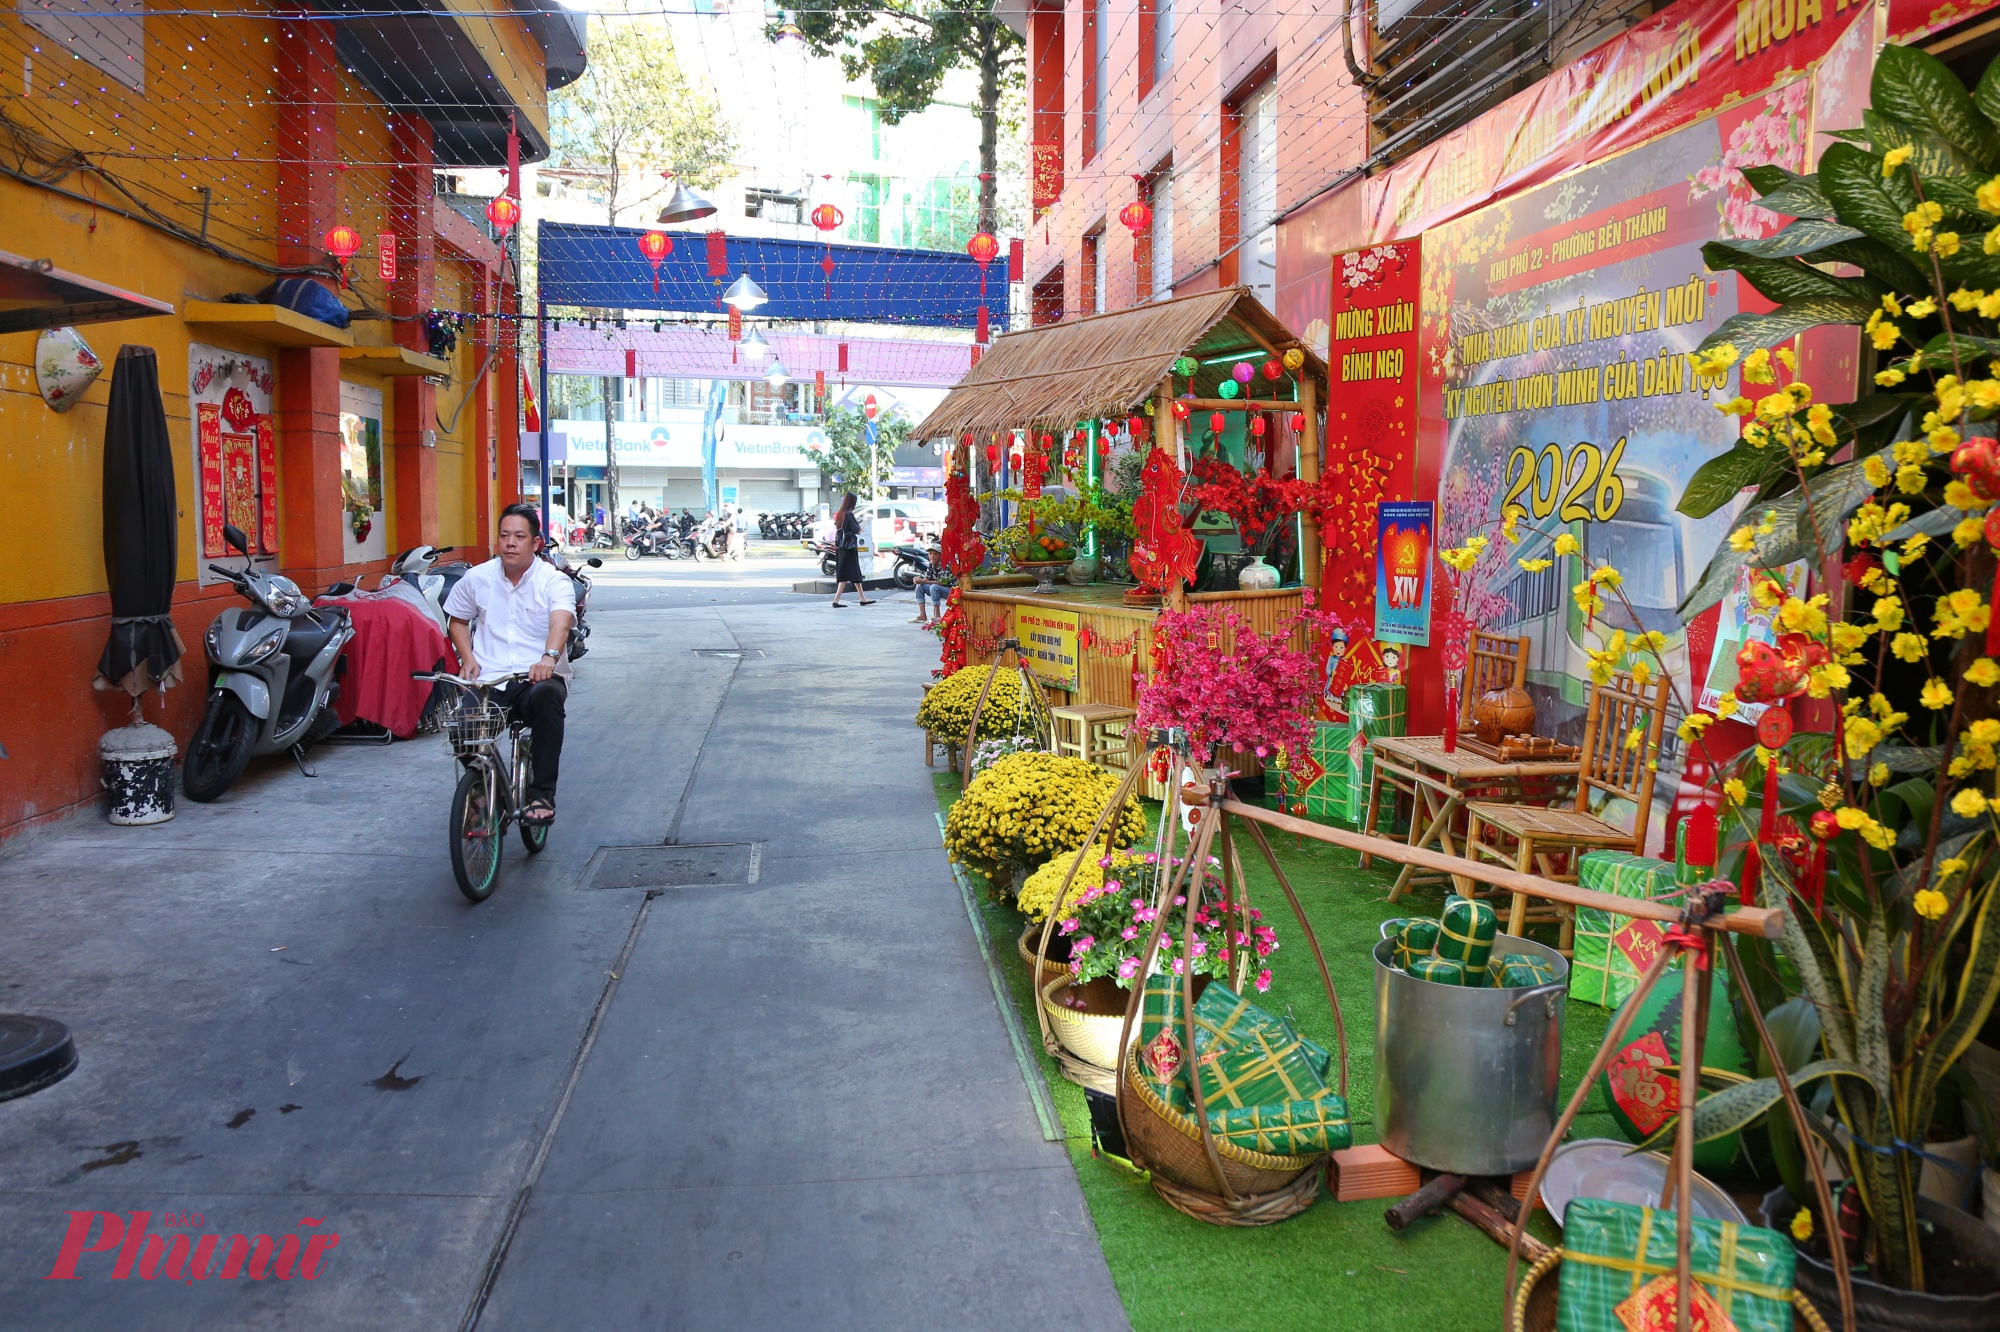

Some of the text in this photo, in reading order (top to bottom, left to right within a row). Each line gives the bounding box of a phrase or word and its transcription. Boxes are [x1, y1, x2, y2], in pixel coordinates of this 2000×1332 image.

[1640, 18, 1700, 105] MỚI
[1490, 256, 1508, 283] KHU
[1510, 244, 1528, 276] PHỐ
[1530, 247, 1543, 271] 22
[1552, 229, 1595, 265] PHƯỜNG
[1598, 216, 1622, 251] BẾN
[1625, 206, 1667, 242] THÀNH
[1335, 297, 1414, 340] MỪNG XUÂN
[1492, 314, 1529, 359] XUÂN
[1532, 304, 1561, 352] CỦA
[1565, 296, 1587, 345] KỶ
[1589, 286, 1660, 341] NGUYÊN
[1664, 274, 1706, 328] MỚI
[1341, 347, 1404, 384] BÍNH NGỌ
[1464, 376, 1512, 417] NGUYÊN
[1515, 372, 1553, 411] VƯƠN
[1556, 362, 1600, 406] MÌNH
[1603, 352, 1639, 402] CỦA
[1643, 349, 1684, 398] DÂN
[571, 436, 652, 452] VietiBank
[1501, 435, 1627, 524] 2026
[1392, 575, 1419, 603] XIV
